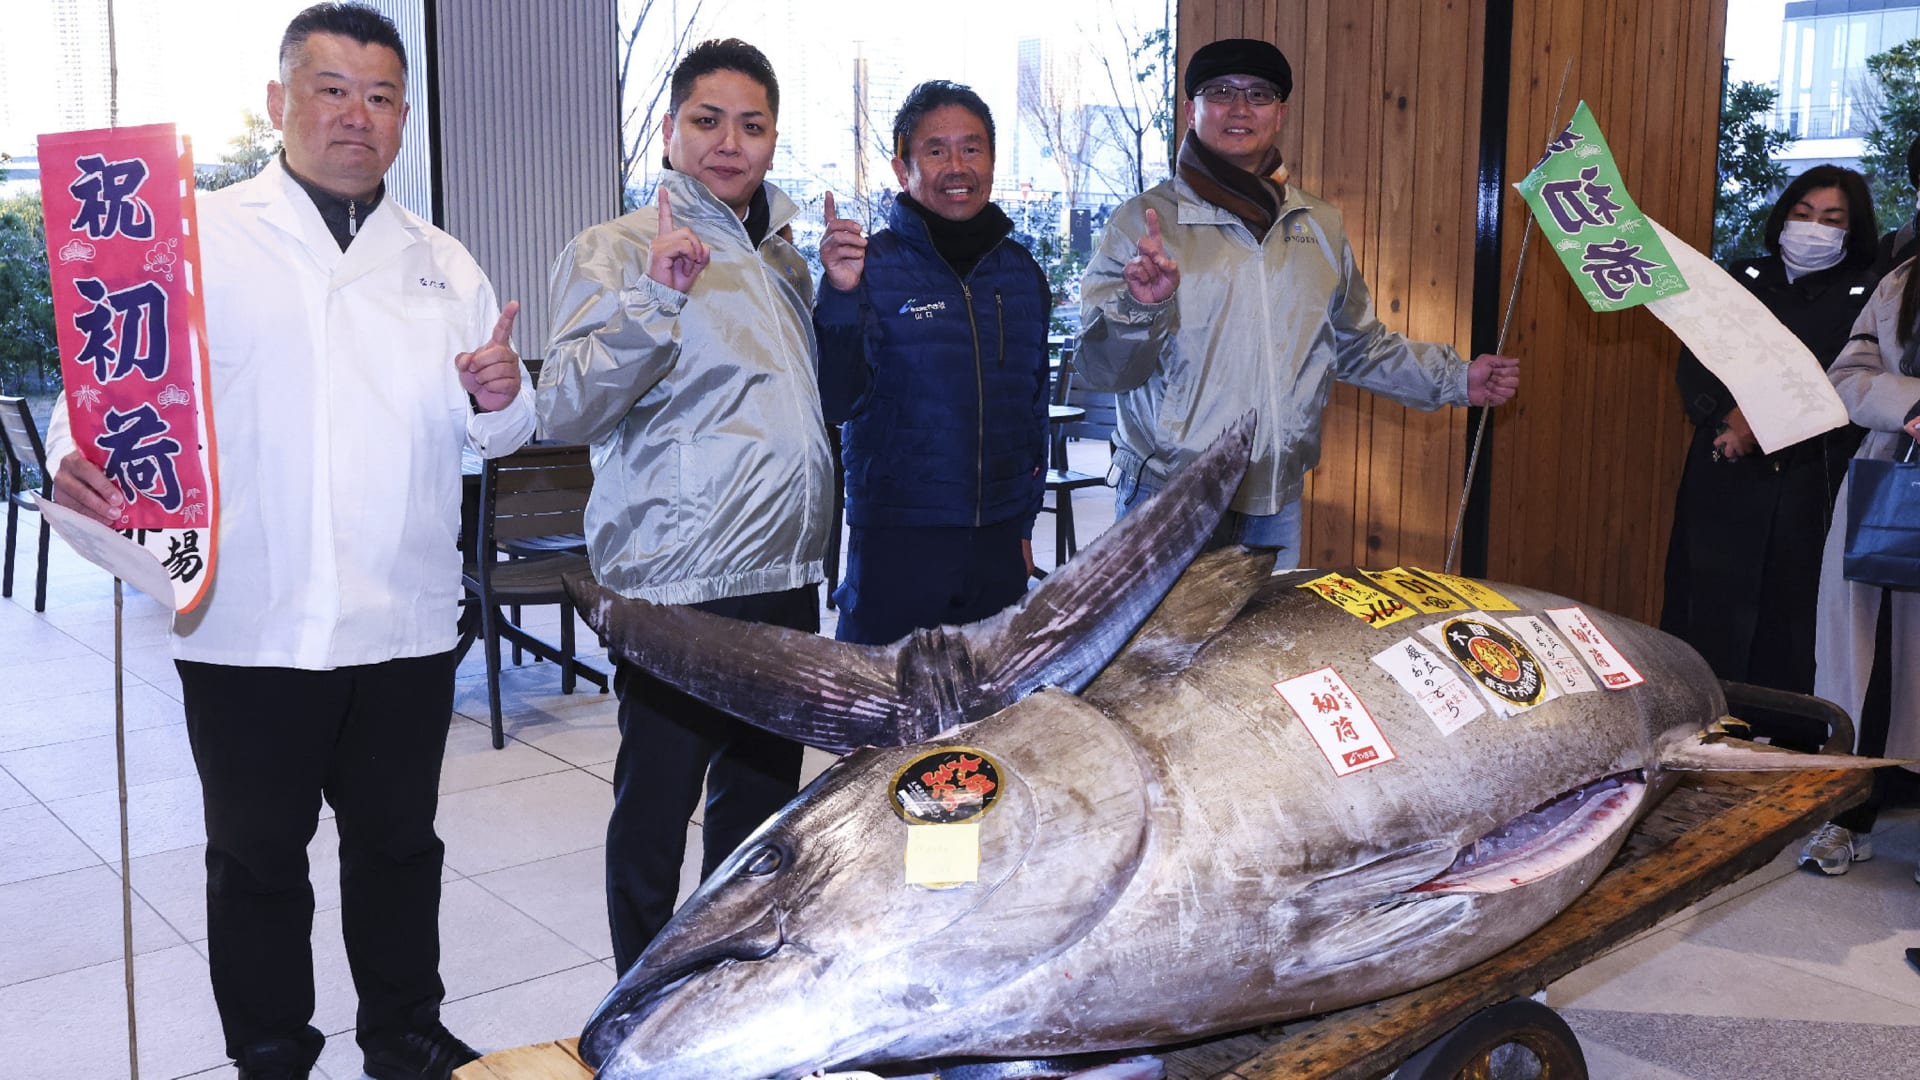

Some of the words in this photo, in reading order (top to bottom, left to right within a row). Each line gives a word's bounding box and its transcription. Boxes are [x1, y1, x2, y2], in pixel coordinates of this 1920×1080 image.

[69, 153, 183, 514] 祝初荷
[1310, 692, 1360, 743] 初荷
[1411, 664, 1460, 718] おのでら
